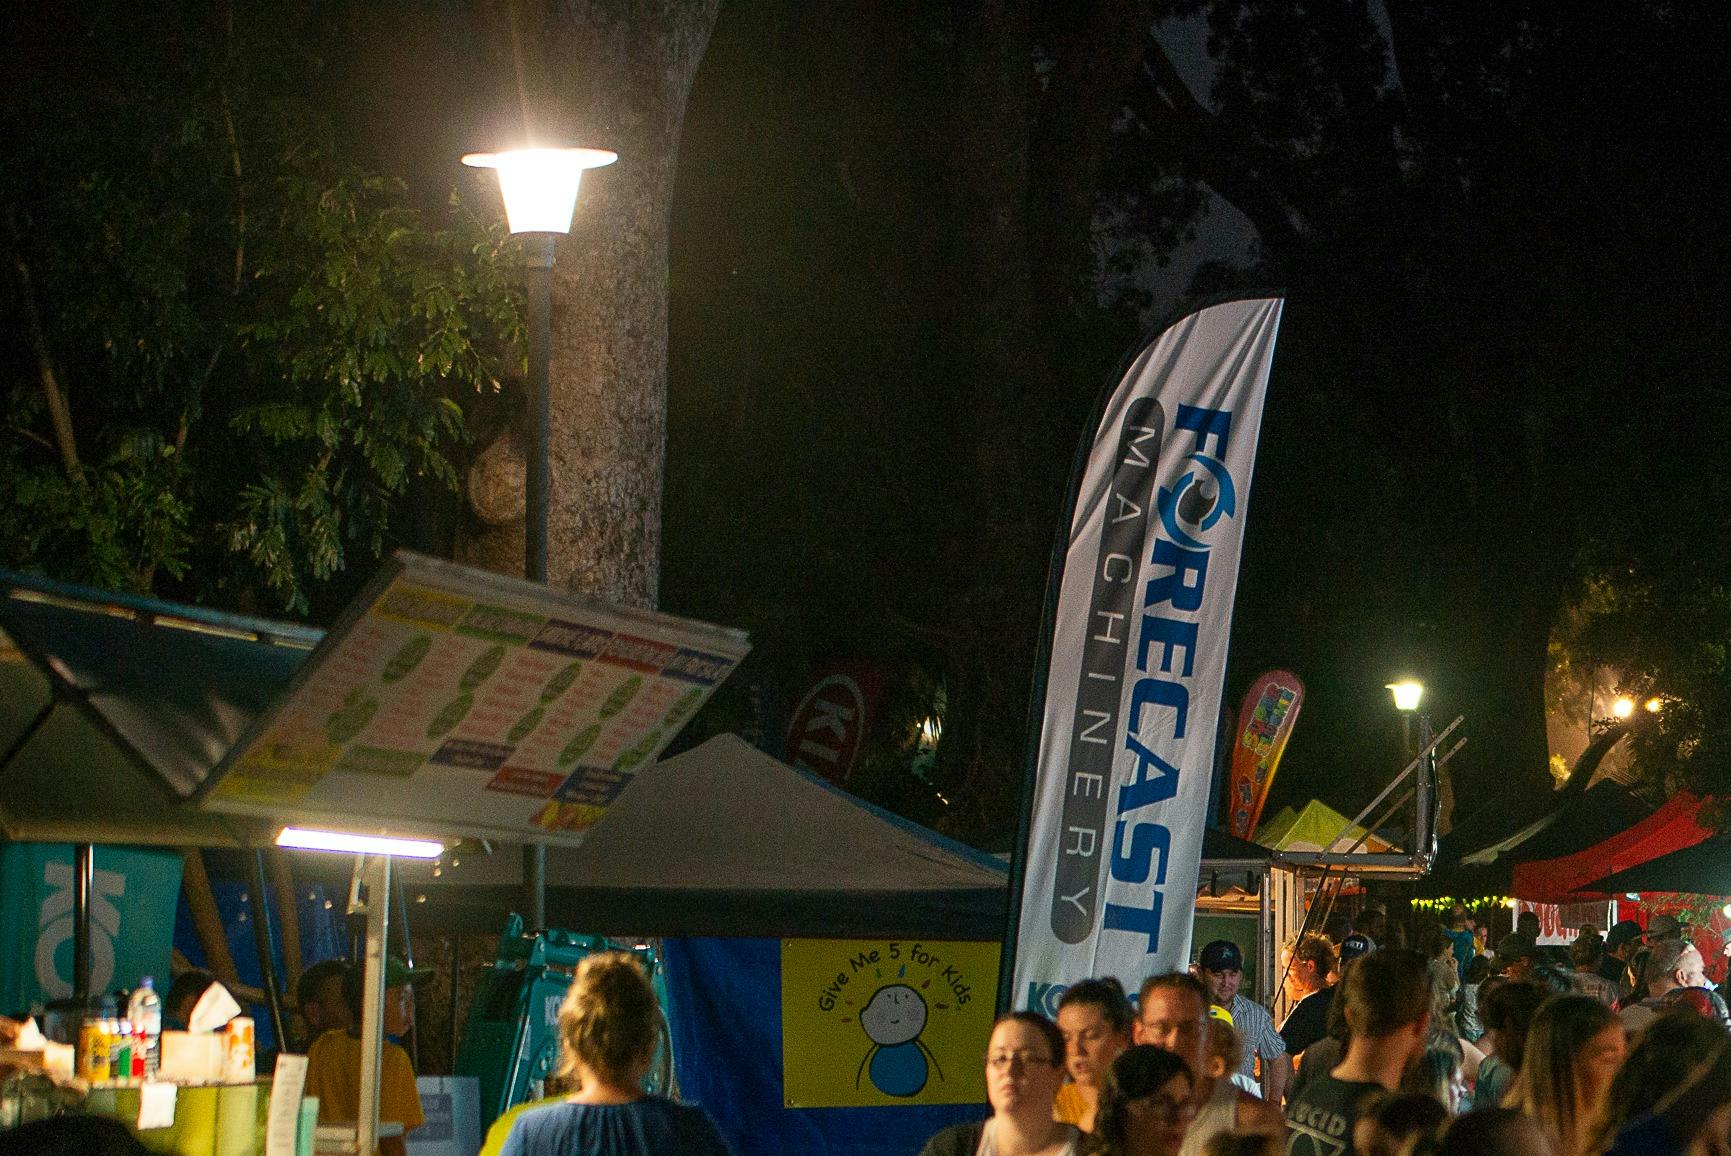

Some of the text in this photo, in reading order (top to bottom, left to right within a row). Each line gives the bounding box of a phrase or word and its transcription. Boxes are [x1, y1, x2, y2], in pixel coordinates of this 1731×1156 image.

[794, 698, 855, 766] KI
[1060, 424, 1156, 918] MACHINERY
[1103, 402, 1236, 955] FORECAST
[819, 942, 972, 1012] Give Me 5 for Kids
